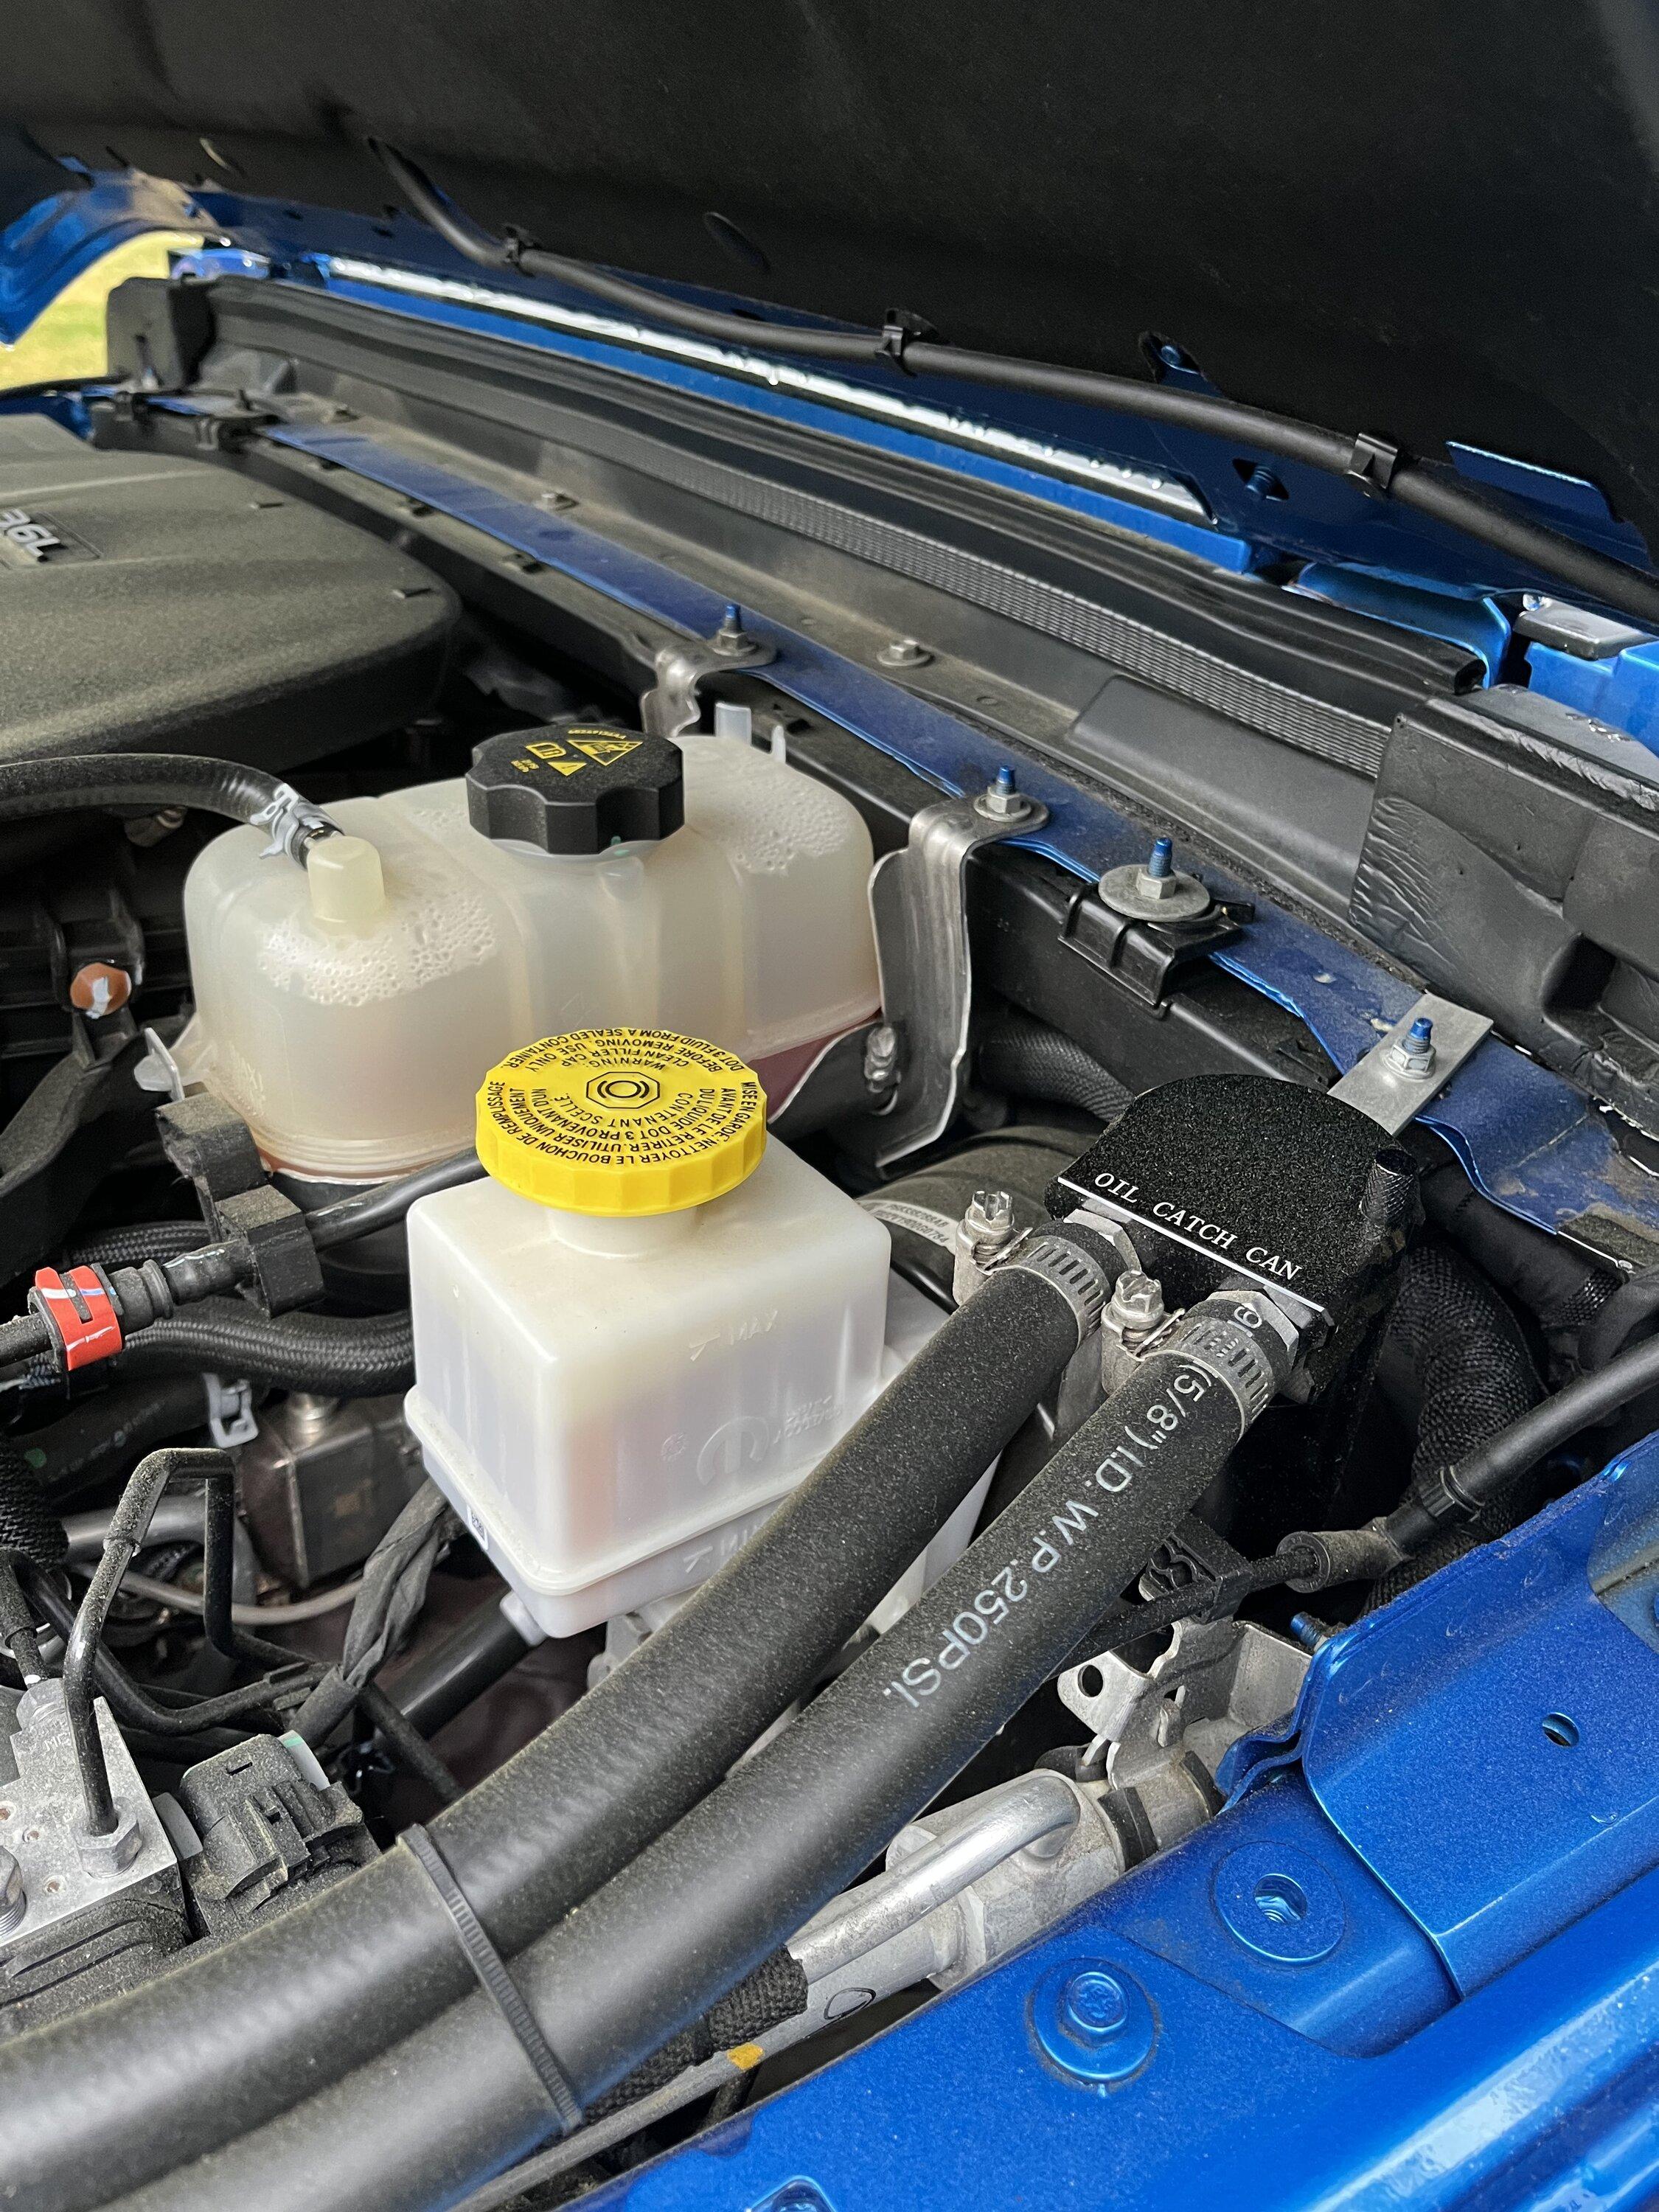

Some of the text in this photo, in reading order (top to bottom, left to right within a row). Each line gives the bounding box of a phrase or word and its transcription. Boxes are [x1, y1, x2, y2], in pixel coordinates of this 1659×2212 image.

[569, 1029, 624, 1040] SEALED
[639, 1029, 681, 1041] FROM
[500, 1036, 569, 1068] CONTAINER.
[556, 1043, 587, 1055] USE
[680, 1037, 715, 1054] FLUID
[525, 1052, 557, 1073] ONLY
[561, 1048, 689, 1067] CLEAN FILLER CAP
[582, 1057, 666, 1071] WARNING:
[674, 1047, 723, 1072] BEFORE
[720, 1057, 745, 1071] DOT
[741, 1082, 758, 1099] MISE
[487, 1081, 523, 1135] REMPLISSAGE
[717, 1088, 737, 1114] AVANT
[739, 1101, 757, 1112] EN
[509, 1088, 556, 1137] UNIQUEMENT
[608, 1093, 693, 1128] CONTENANT
[669, 1099, 713, 1130] LIQUIDE
[705, 1113, 727, 1125] DE
[537, 1108, 620, 1141] PROVENANT
[640, 1126, 671, 1138] DOT
[692, 1123, 713, 1135] LE
[516, 1133, 539, 1145] DE
[553, 1133, 622, 1152] UTILISER
[625, 1131, 634, 1140] 3
[535, 1141, 611, 1164] BOUCHON
[616, 1155, 634, 1164] LE
[639, 1138, 717, 1164] NETTOYER
[1094, 1172, 1303, 1281] OIL CATCH CAN
